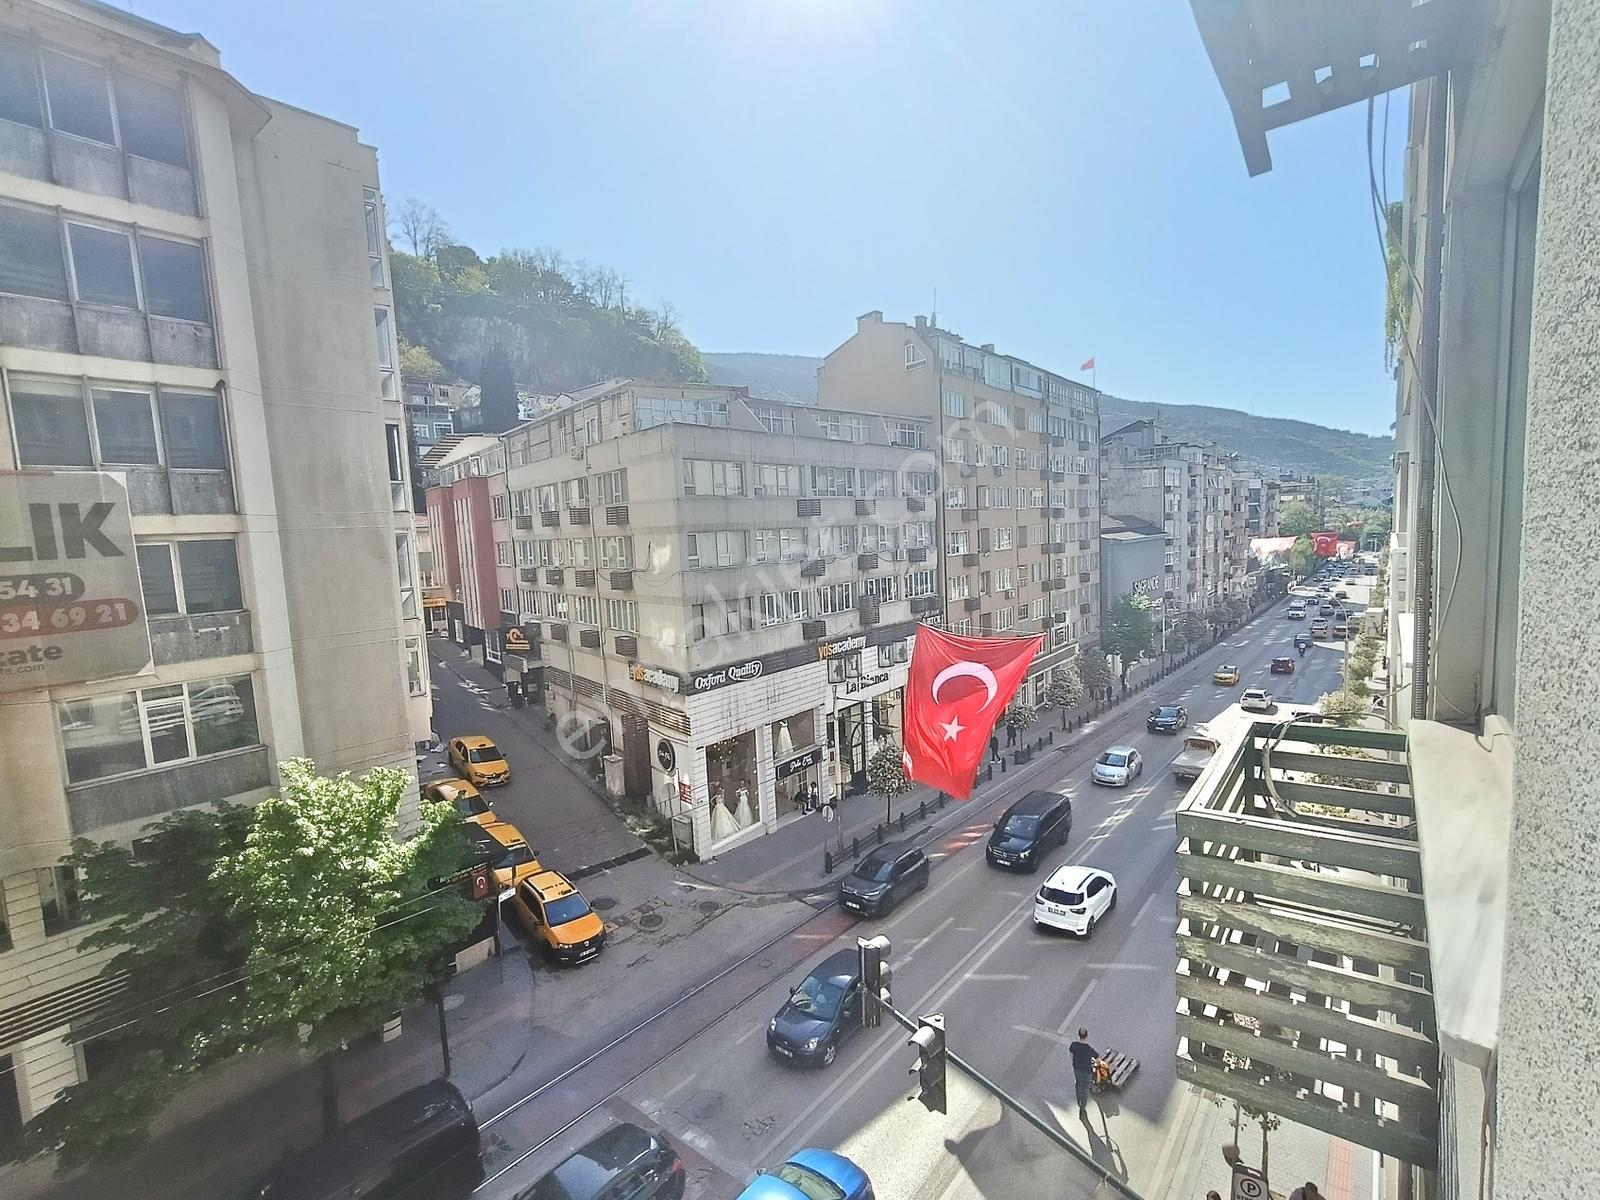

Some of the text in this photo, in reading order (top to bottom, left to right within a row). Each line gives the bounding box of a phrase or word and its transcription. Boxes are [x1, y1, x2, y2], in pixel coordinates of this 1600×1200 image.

[45, 576, 72, 597] 31
[1, 603, 127, 633] 34 69 21
[695, 660, 763, 690] Oxford Quality
